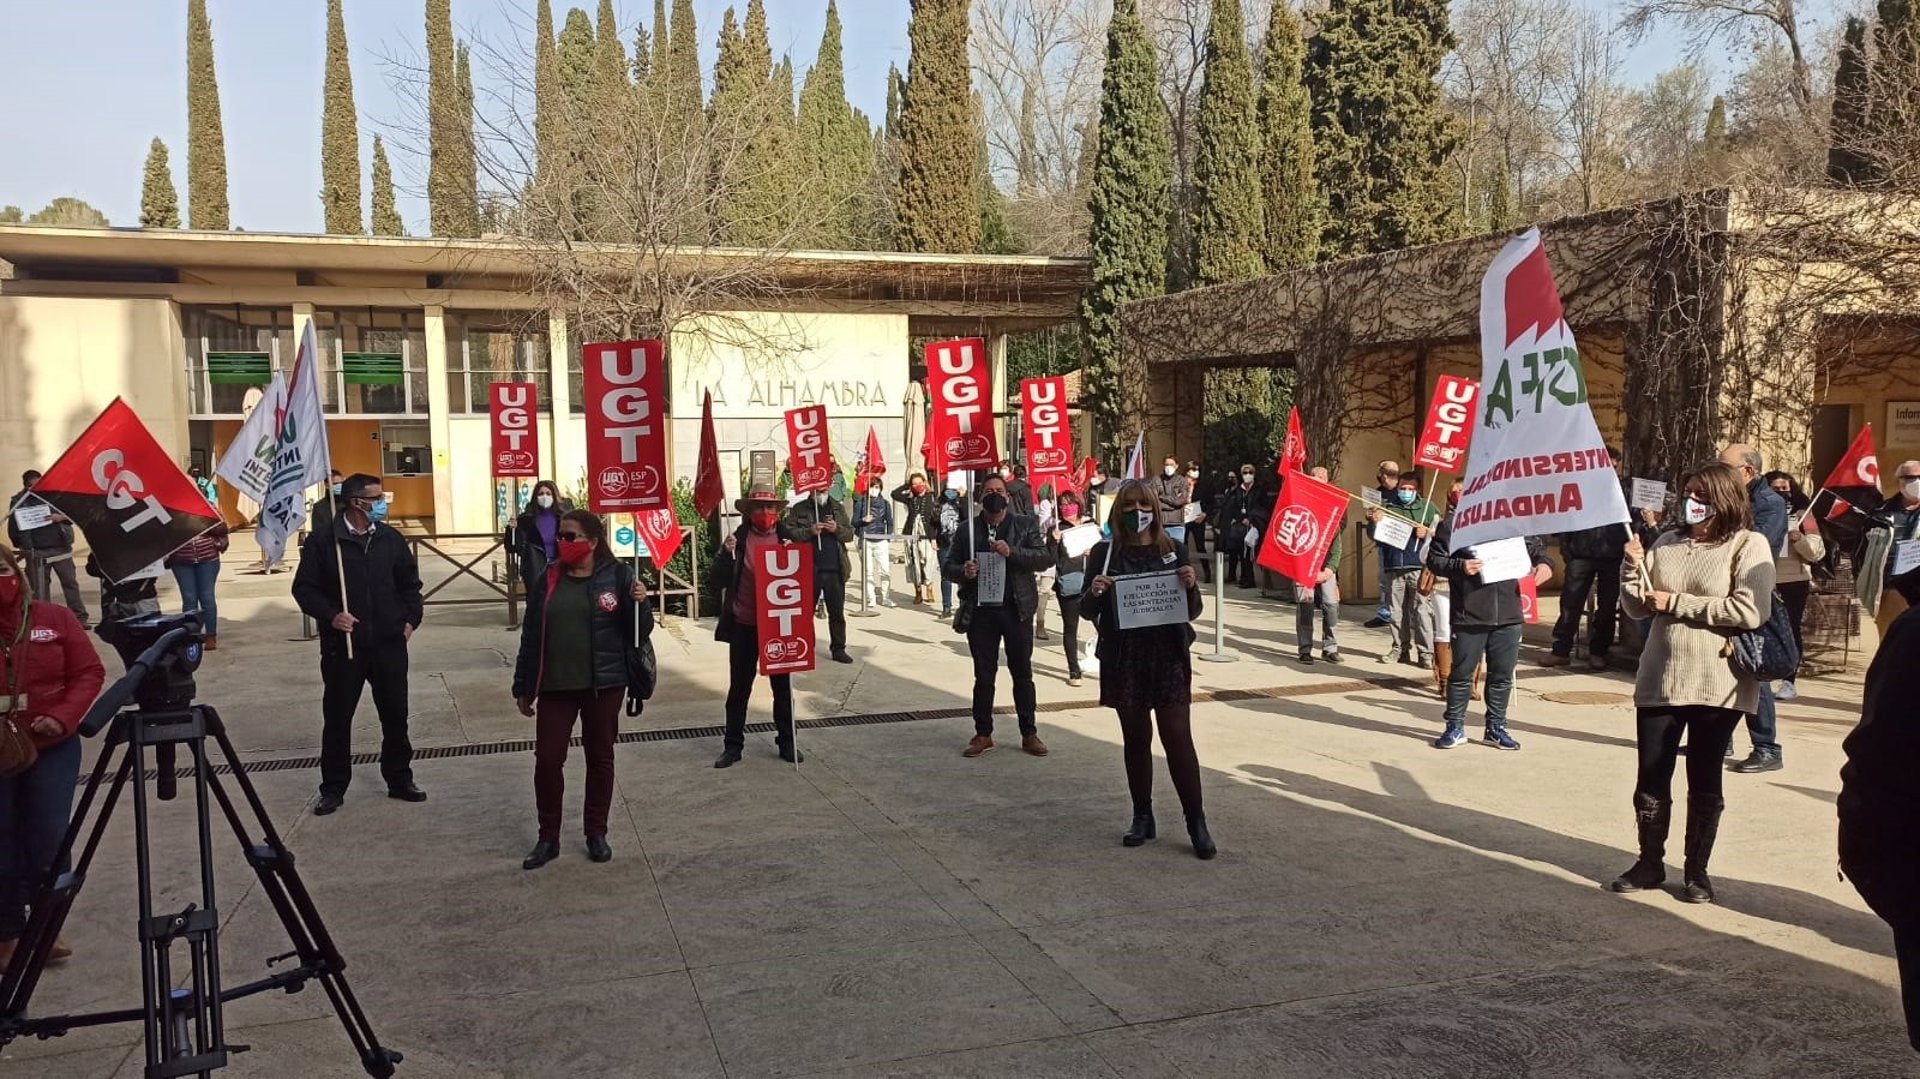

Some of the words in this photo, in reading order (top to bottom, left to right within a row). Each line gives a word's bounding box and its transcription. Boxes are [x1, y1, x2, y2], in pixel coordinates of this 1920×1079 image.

[499, 387, 528, 450] UGT
[601, 348, 651, 464] UGT
[695, 380, 727, 407] LA
[748, 379, 887, 407] ALHAMBRA
[938, 345, 980, 434] UGT
[1029, 382, 1060, 449] UGT
[1435, 381, 1475, 444] UGT
[794, 410, 821, 468] UGT
[91, 449, 172, 533] CGT
[602, 472, 625, 484] UGT
[630, 471, 647, 481] ESP
[1277, 509, 1301, 547] UGT
[765, 549, 802, 637] UGT
